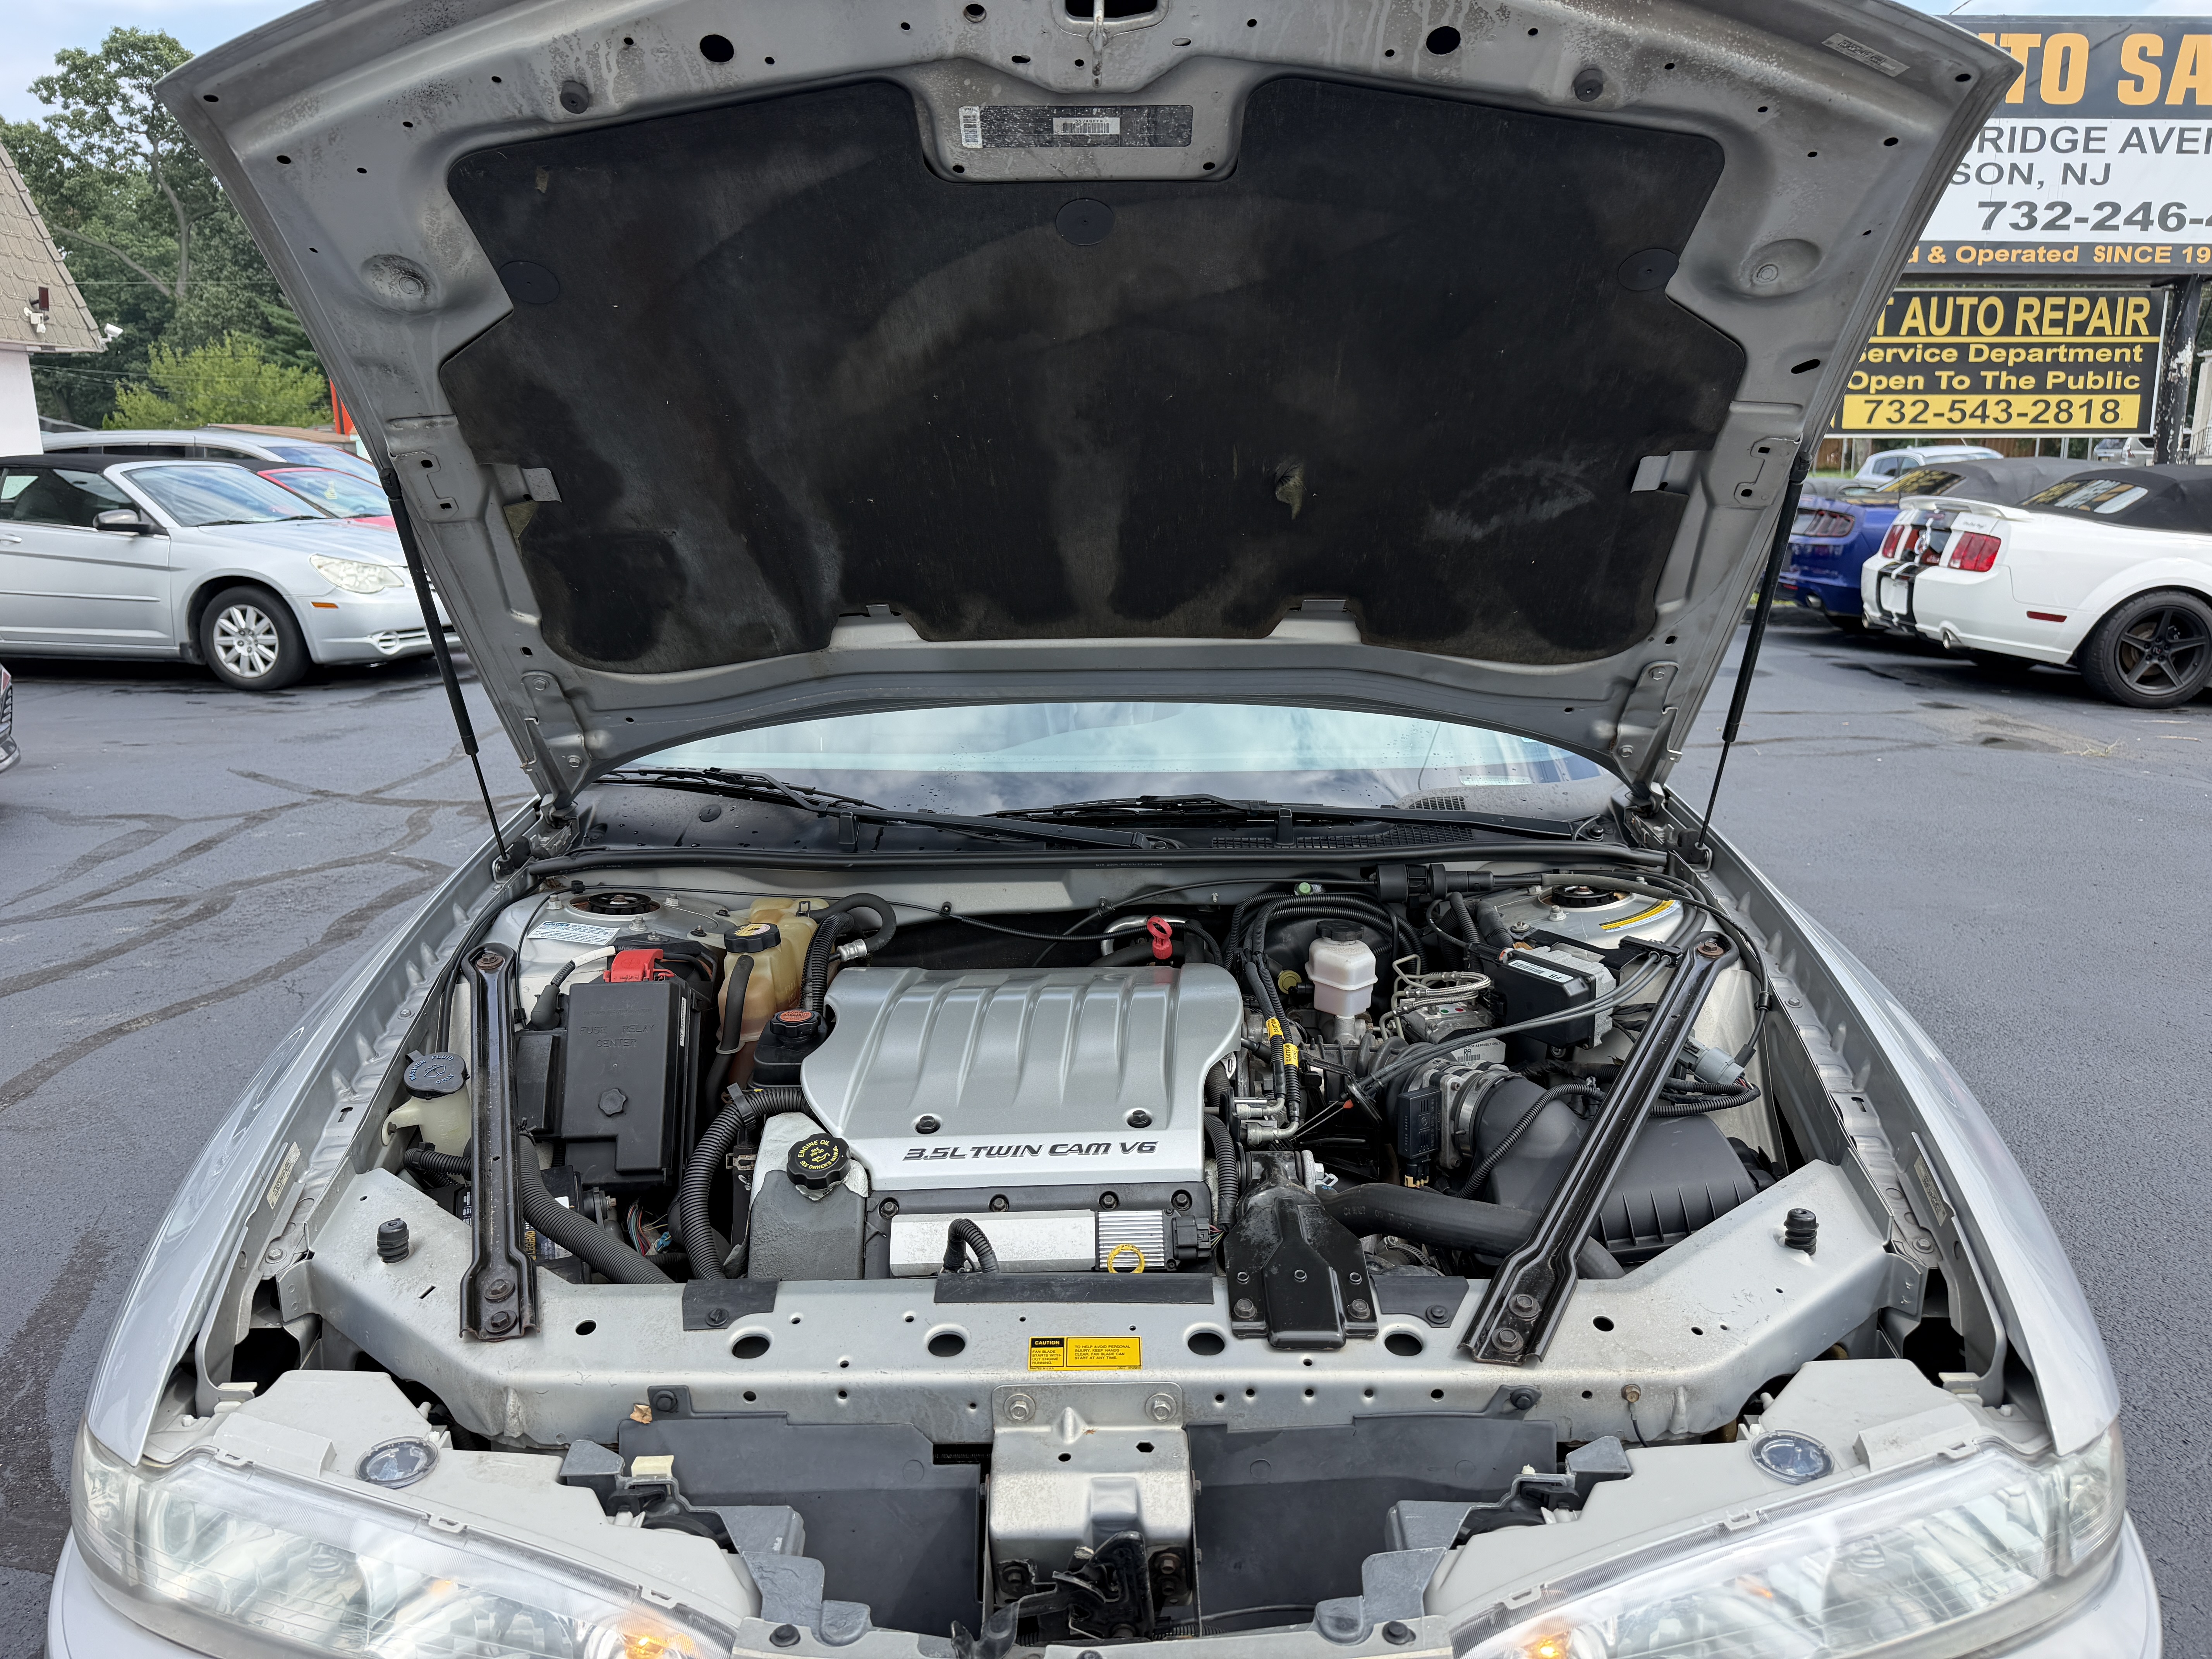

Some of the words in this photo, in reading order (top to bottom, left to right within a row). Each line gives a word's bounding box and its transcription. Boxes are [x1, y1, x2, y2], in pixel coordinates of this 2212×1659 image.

[1978, 33, 2089, 105] TO
[2118, 33, 2212, 105] SA
[1970, 126, 2108, 154] RIDGE
[1950, 162, 2044, 190] SON,
[2061, 163, 2111, 185] NJ
[1978, 201, 2212, 232] 732-246-
[1927, 246, 1946, 264] &
[1955, 245, 2079, 266] Operated
[2093, 246, 2172, 263] SINCE
[2182, 246, 2211, 264] 19
[1899, 297, 2004, 336] AUTO
[2014, 297, 2150, 336] REPAIR
[1968, 343, 2143, 367] Department
[1848, 370, 1924, 394] Open
[1935, 371, 1970, 390] To
[1980, 371, 2035, 390] The
[2046, 371, 2140, 390] Public
[1863, 398, 2121, 425] 732-543-2818
[580, 1026, 607, 1035] FUSE
[622, 1024, 654, 1034] RELAY
[1271, 1019, 1279, 1033] CAUTION
[596, 1039, 637, 1048] CENTER
[409, 1059, 426, 1081] WASHER
[435, 1073, 455, 1085] ONLY
[798, 1140, 819, 1158] ENGINE
[808, 1161, 832, 1170] OWNER'S
[830, 1145, 839, 1162] MANUAL
[902, 1147, 969, 1161] 3.5L
[969, 1144, 1045, 1159] TWIN
[1048, 1142, 1113, 1156] CAM
[1119, 1141, 1159, 1155] V6
